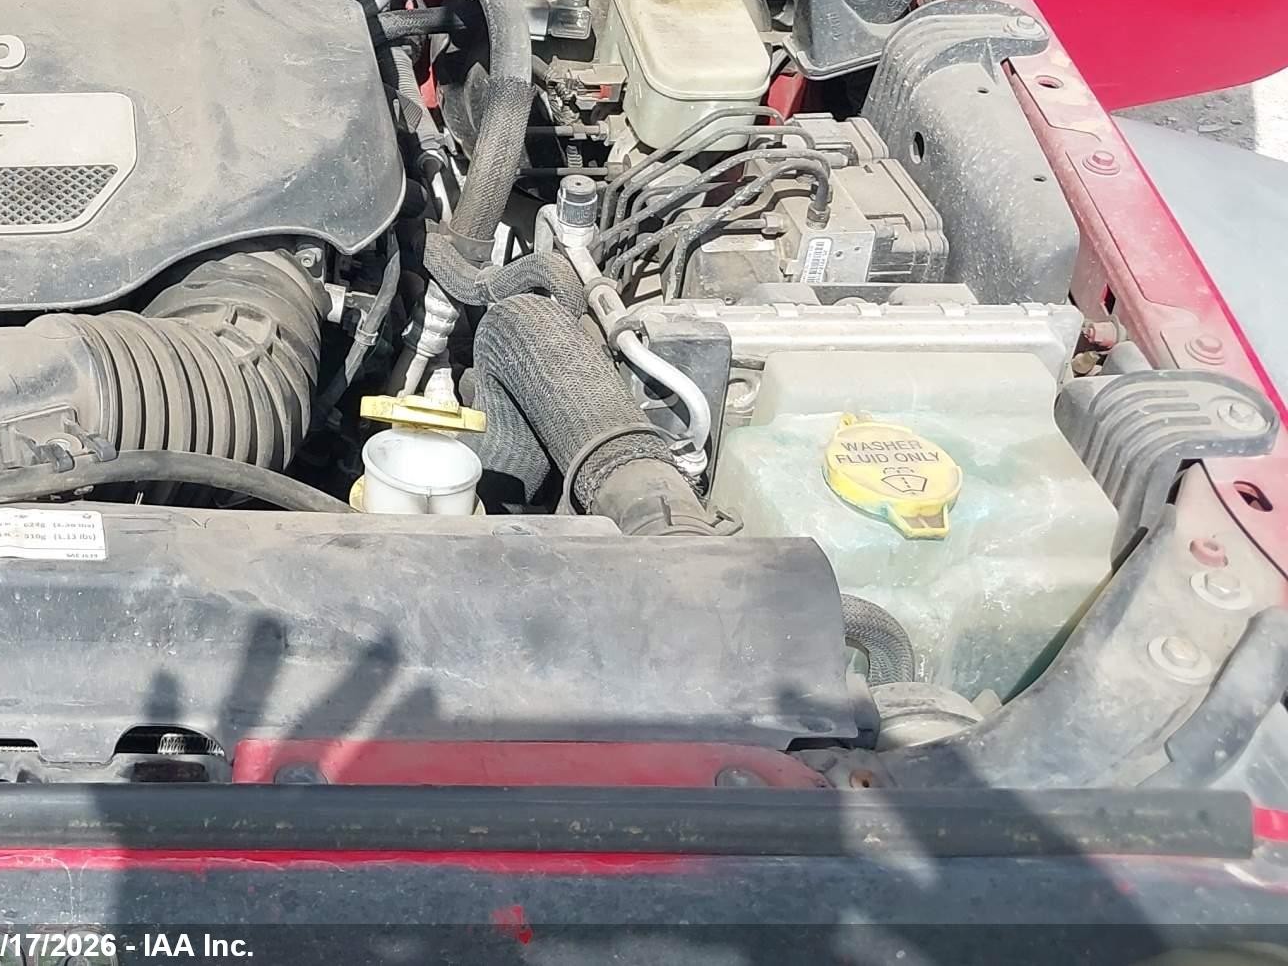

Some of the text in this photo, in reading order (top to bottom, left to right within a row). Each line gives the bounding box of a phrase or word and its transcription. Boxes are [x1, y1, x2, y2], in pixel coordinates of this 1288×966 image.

[840, 440, 923, 452] WASHER
[835, 451, 940, 465] FLUID ONLY
